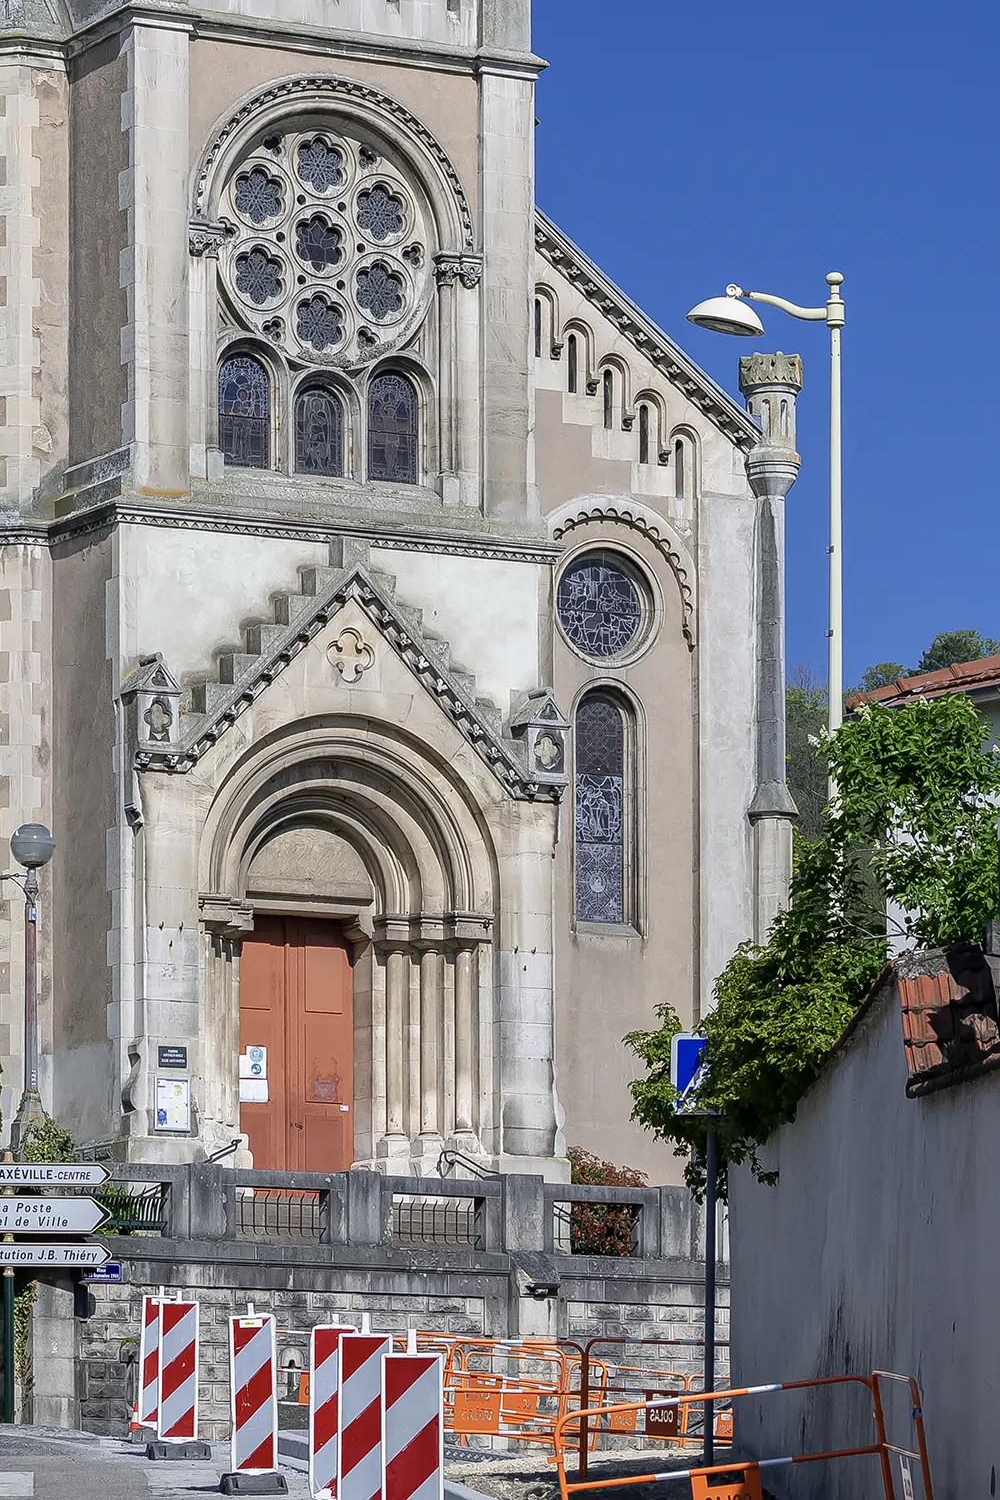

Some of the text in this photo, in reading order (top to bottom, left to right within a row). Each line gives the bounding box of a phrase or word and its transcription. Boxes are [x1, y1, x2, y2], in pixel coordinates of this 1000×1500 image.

[16, 1202, 52, 1213] Poste
[15, 1216, 30, 1227] de
[38, 1216, 69, 1227] Ville
[38, 1250, 58, 1260] J.B.
[63, 1250, 98, 1263] Thiéry
